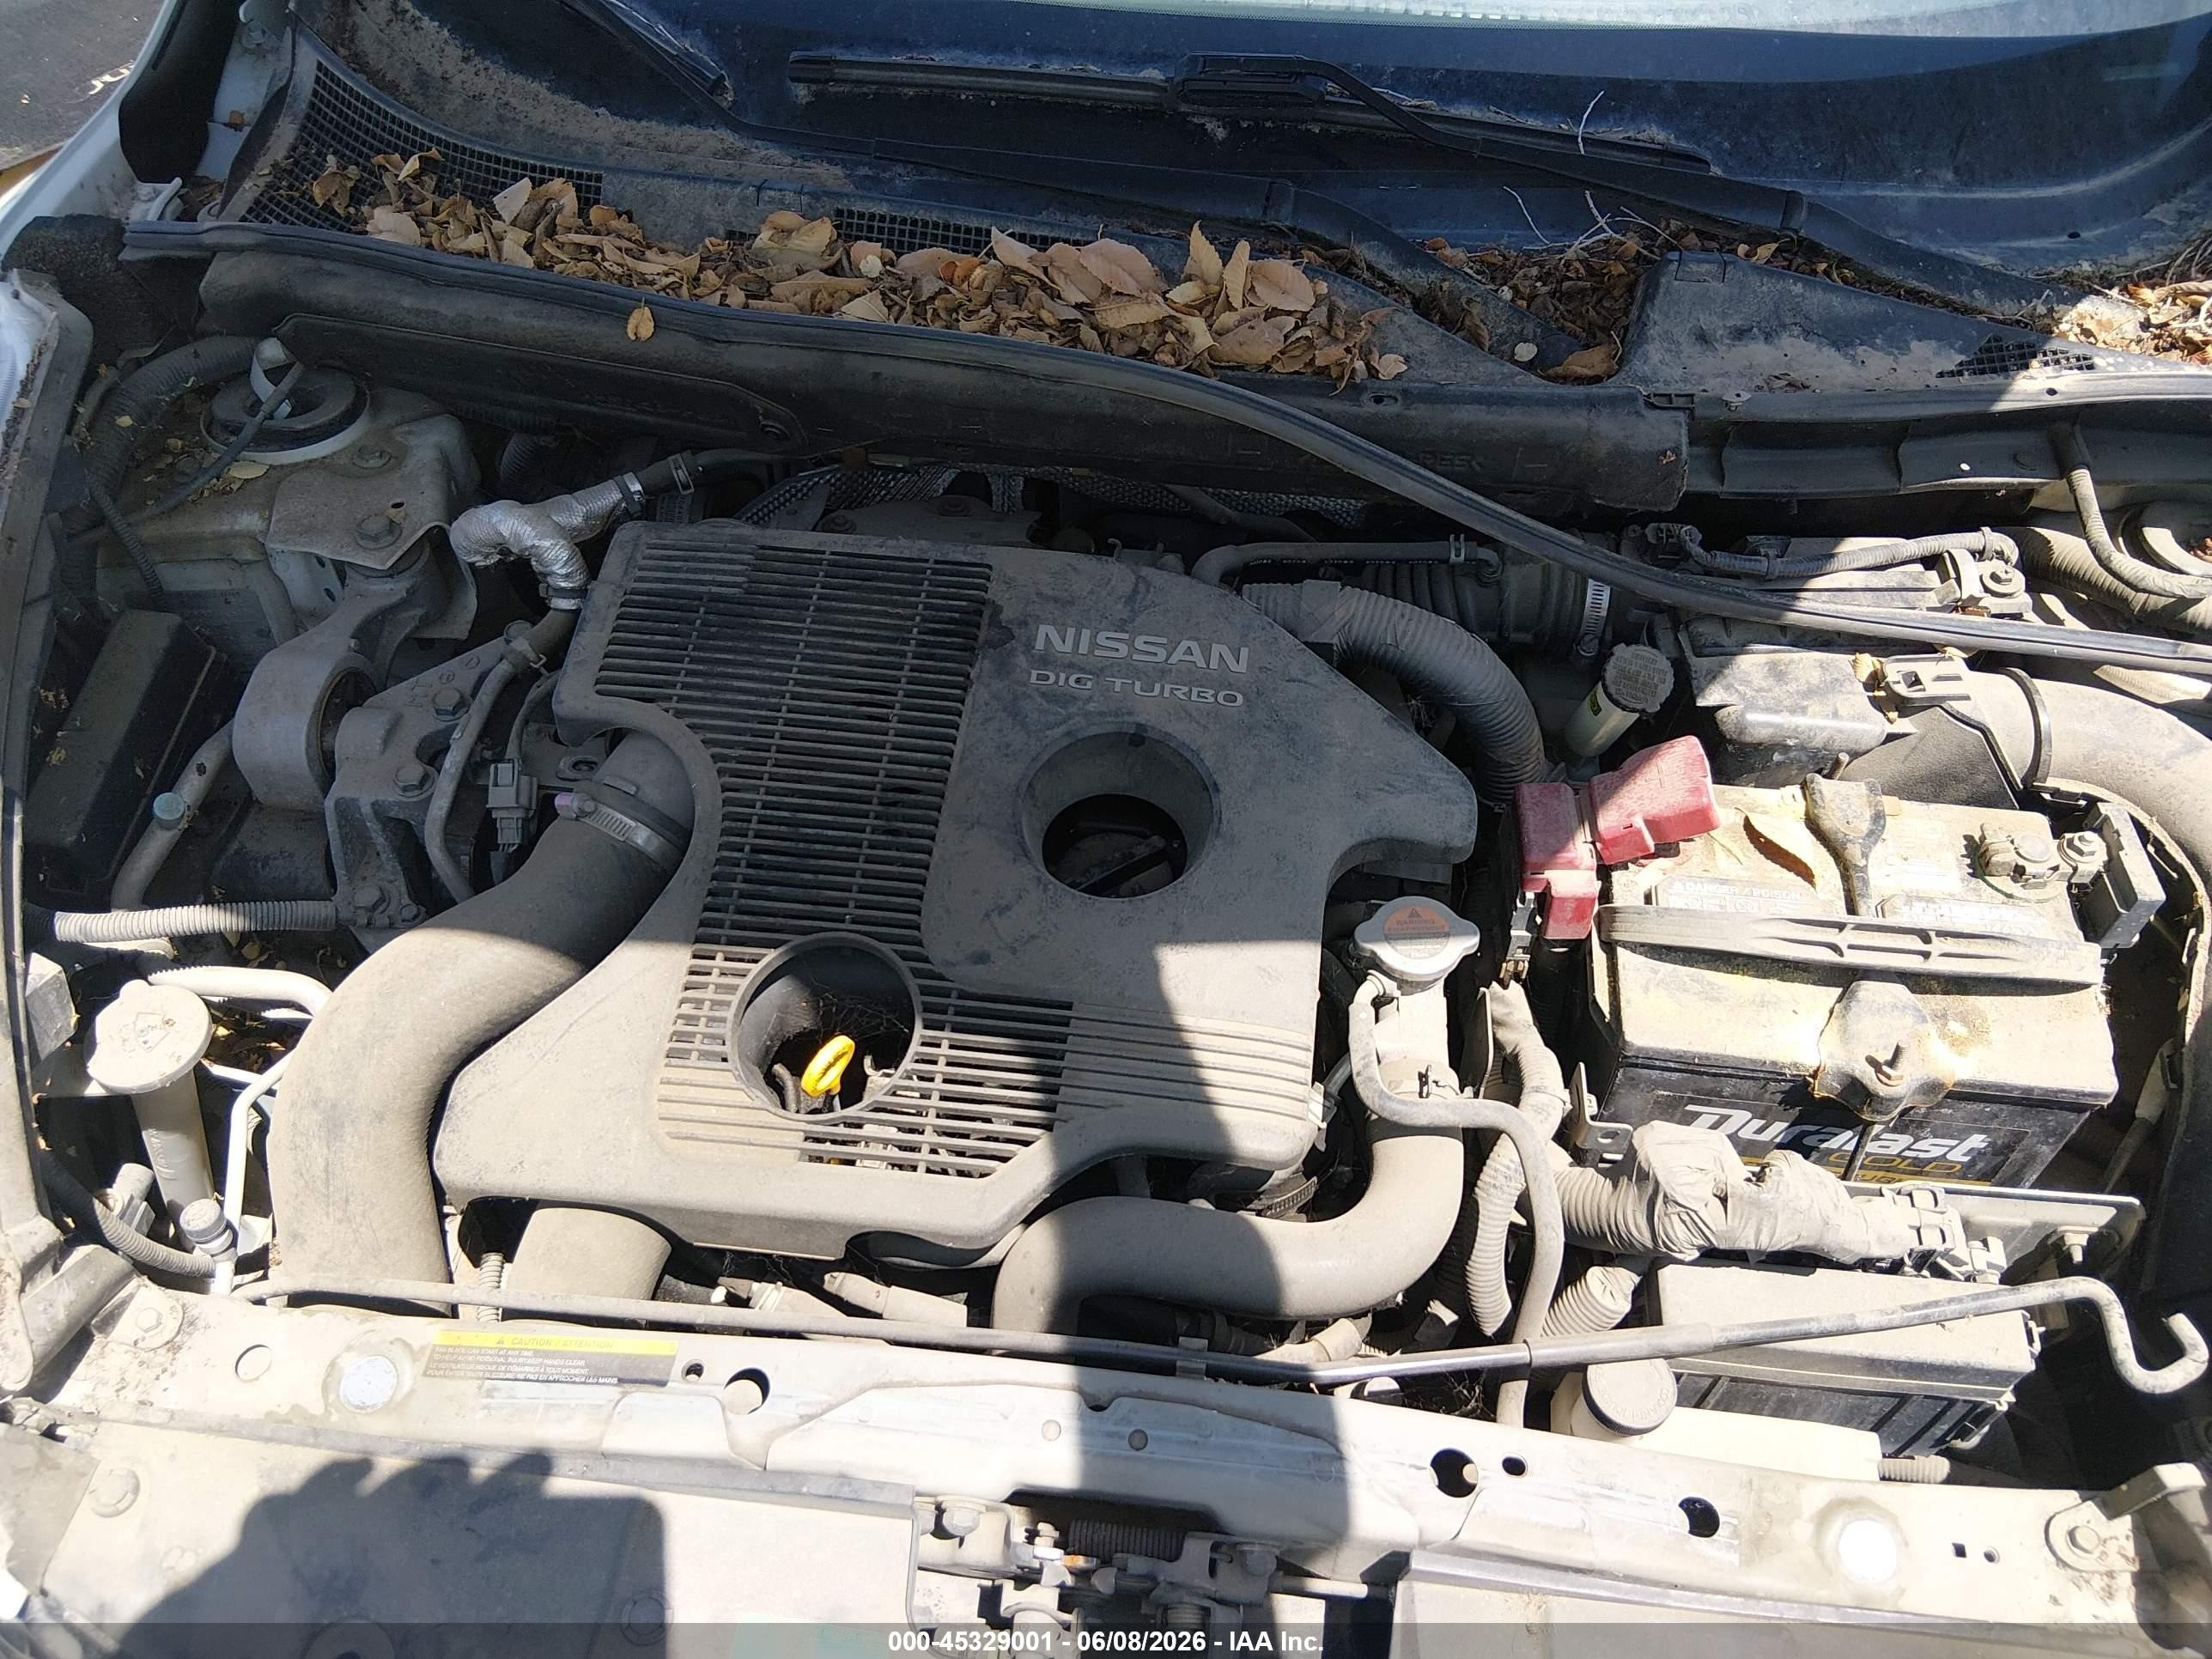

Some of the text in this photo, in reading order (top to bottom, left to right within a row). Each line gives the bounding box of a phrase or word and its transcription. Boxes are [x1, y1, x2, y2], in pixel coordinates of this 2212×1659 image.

[1034, 624, 1249, 673] NISSAN
[1030, 670, 1244, 707] DIG TURBO
[1686, 882, 1737, 896] DANGER
[1752, 888, 1801, 901] POISON
[1683, 1103, 1990, 1163] Duralast
[511, 1337, 552, 1347] CAUTION
[562, 1339, 613, 1349] ATTENTION
